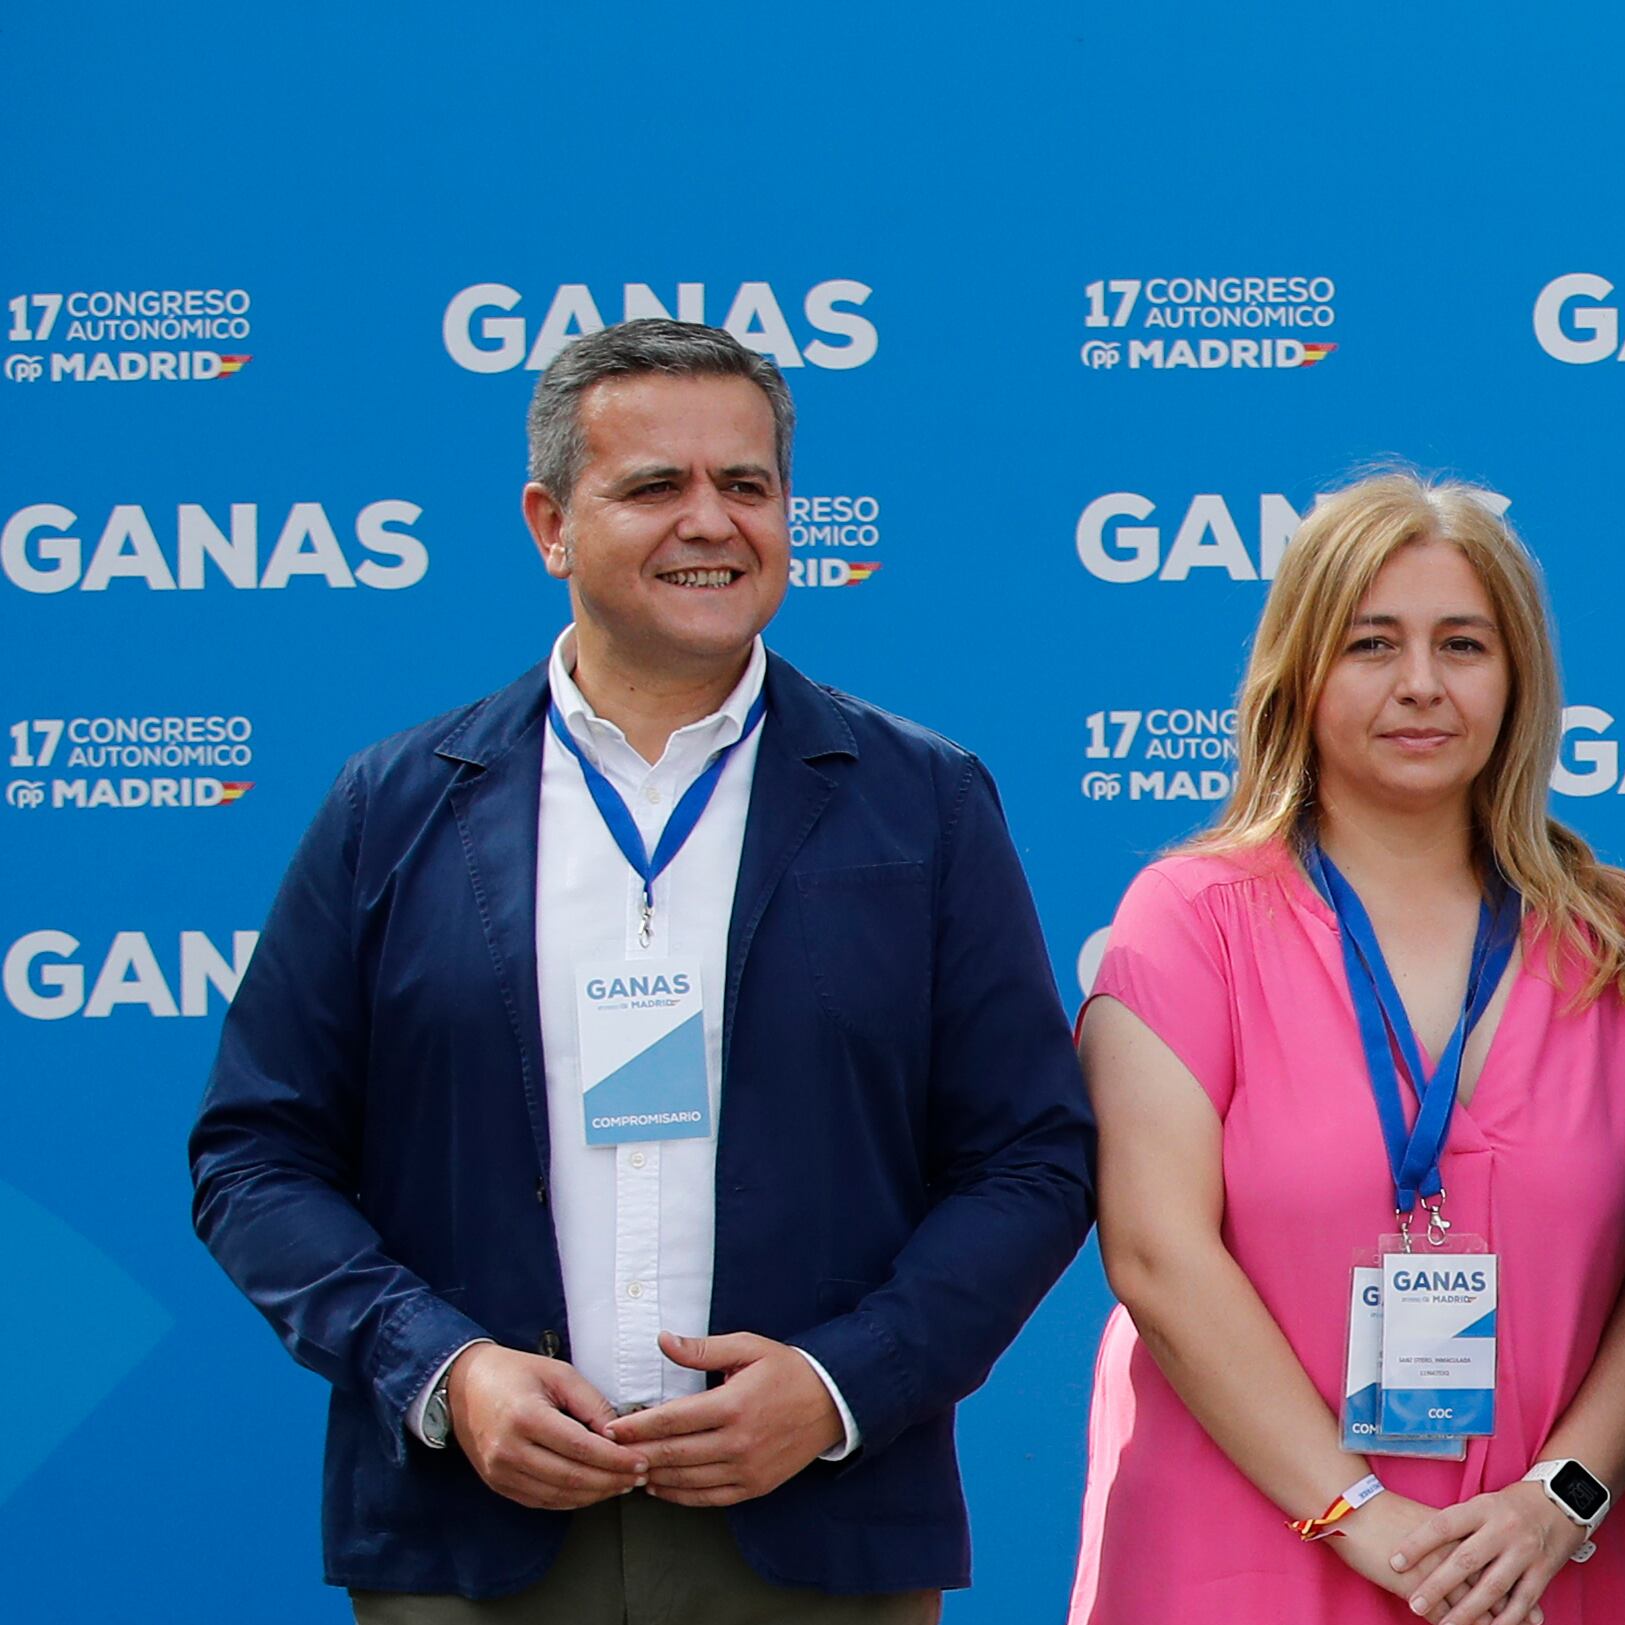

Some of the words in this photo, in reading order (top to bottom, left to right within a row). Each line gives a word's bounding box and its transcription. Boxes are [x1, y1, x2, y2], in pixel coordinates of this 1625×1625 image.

[1086, 280, 1141, 326] 17
[1146, 277, 1334, 303] CONGRESO
[1146, 302, 1334, 327] AUTONÓMICO
[10, 294, 62, 340] 17
[67, 290, 249, 316] CONGRESO
[68, 316, 249, 340] AUTONÓMICO
[51, 351, 221, 380] MADRID
[1129, 339, 1305, 368] MADRID
[0, 500, 428, 593] GANAS
[11, 720, 63, 766] 17
[69, 717, 251, 743] CONGRESO
[1087, 711, 1141, 758] 17
[69, 741, 251, 766] AUTONÓMICO
[53, 778, 223, 807] MADRID
[587, 974, 690, 1000] GANAS
[631, 1000, 672, 1009] MADRID
[592, 1111, 702, 1128] COMPROMISARIO
[1393, 1271, 1486, 1291] GANAS
[1432, 1296, 1469, 1304] MADRID
[1428, 1408, 1453, 1419] COC
